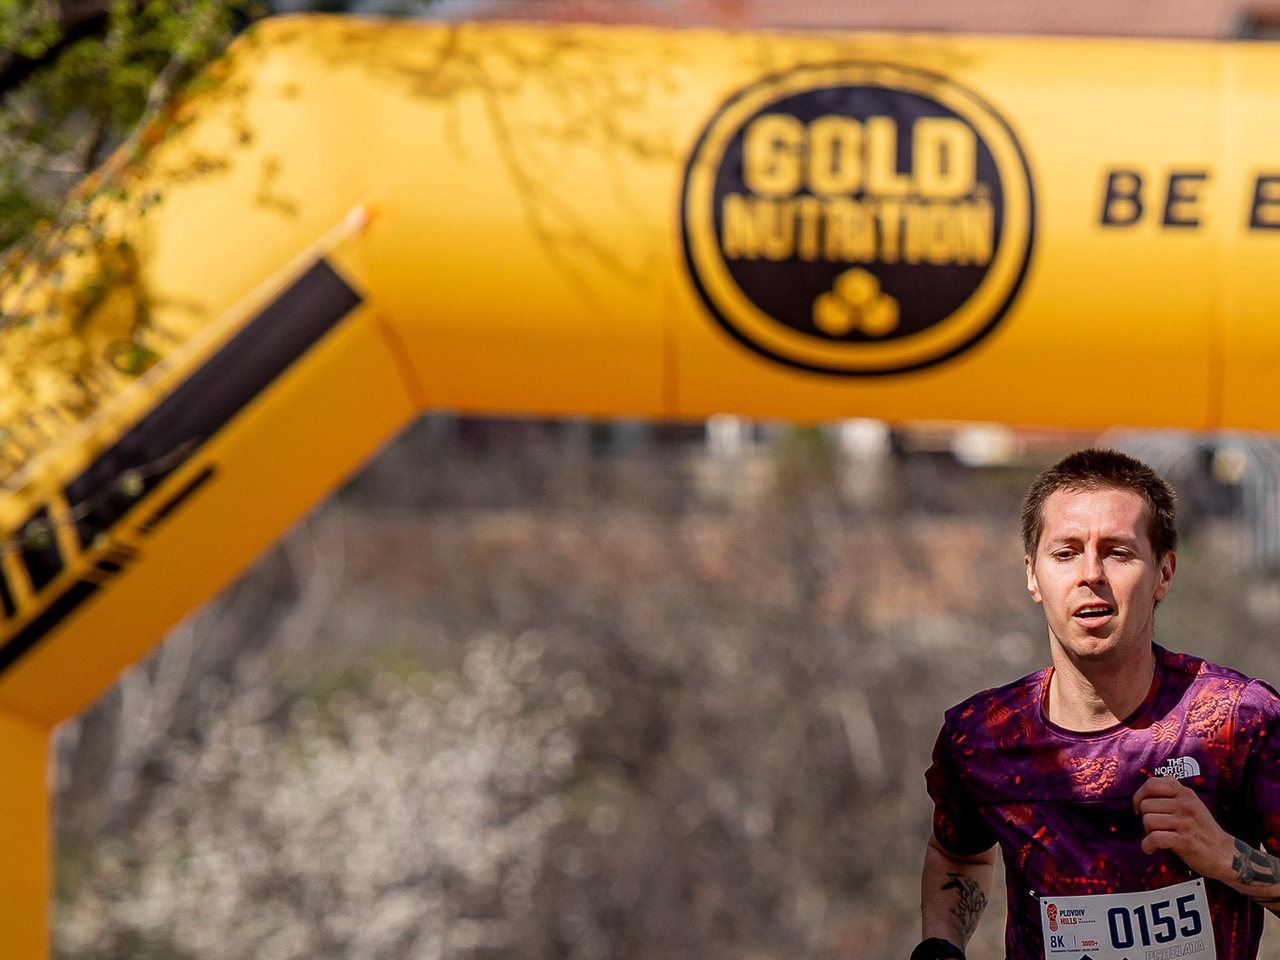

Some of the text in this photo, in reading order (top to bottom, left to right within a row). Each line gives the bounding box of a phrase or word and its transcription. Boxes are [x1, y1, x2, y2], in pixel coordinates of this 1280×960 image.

[743, 113, 977, 198] GOLD
[1099, 169, 1209, 229] BE
[722, 193, 994, 266] NUTRITION
[1154, 766, 1184, 775] NORTH
[1167, 757, 1183, 767] THE
[1060, 909, 1085, 917] PLOVDIV
[1107, 894, 1203, 949] 0155
[1050, 935, 1065, 948] 8K
